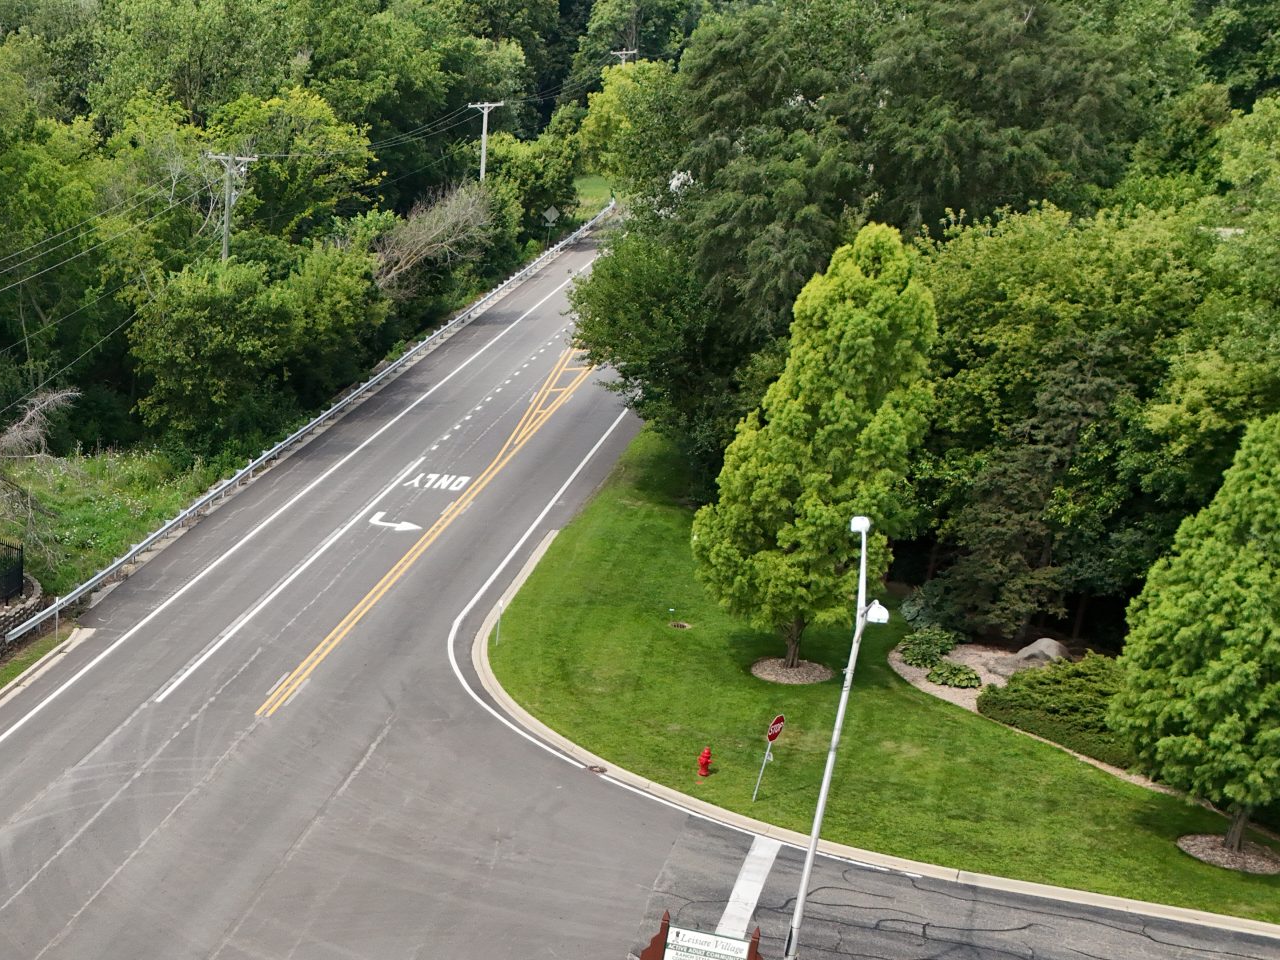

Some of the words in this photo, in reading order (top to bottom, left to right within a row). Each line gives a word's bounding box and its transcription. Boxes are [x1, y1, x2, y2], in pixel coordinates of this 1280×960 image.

[403, 472, 472, 491] ONLY
[768, 722, 784, 735] STOP
[668, 943, 687, 952] ACTIVE
[688, 947, 705, 955] ADULT
[680, 933, 712, 947] Leisure
[714, 940, 744, 954] Village
